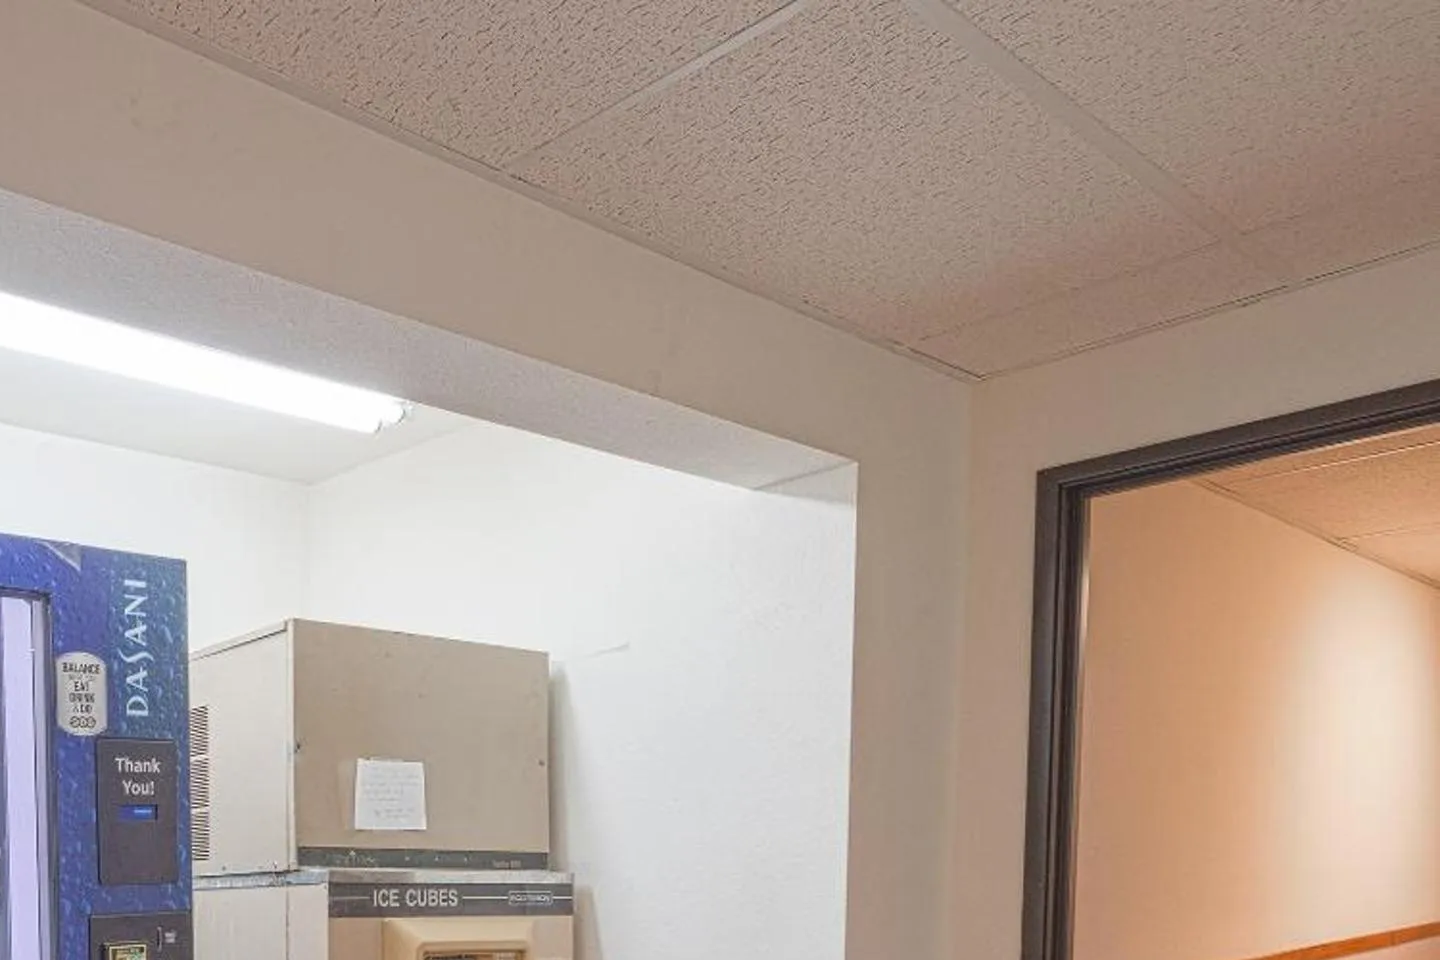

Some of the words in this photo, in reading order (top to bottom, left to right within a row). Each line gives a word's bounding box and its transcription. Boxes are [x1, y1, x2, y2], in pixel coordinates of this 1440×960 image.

[118, 578, 155, 718] DASANI
[114, 757, 160, 774] Thank
[122, 779, 155, 796] You!
[373, 888, 400, 907] ICE
[405, 888, 458, 907] CUBES
